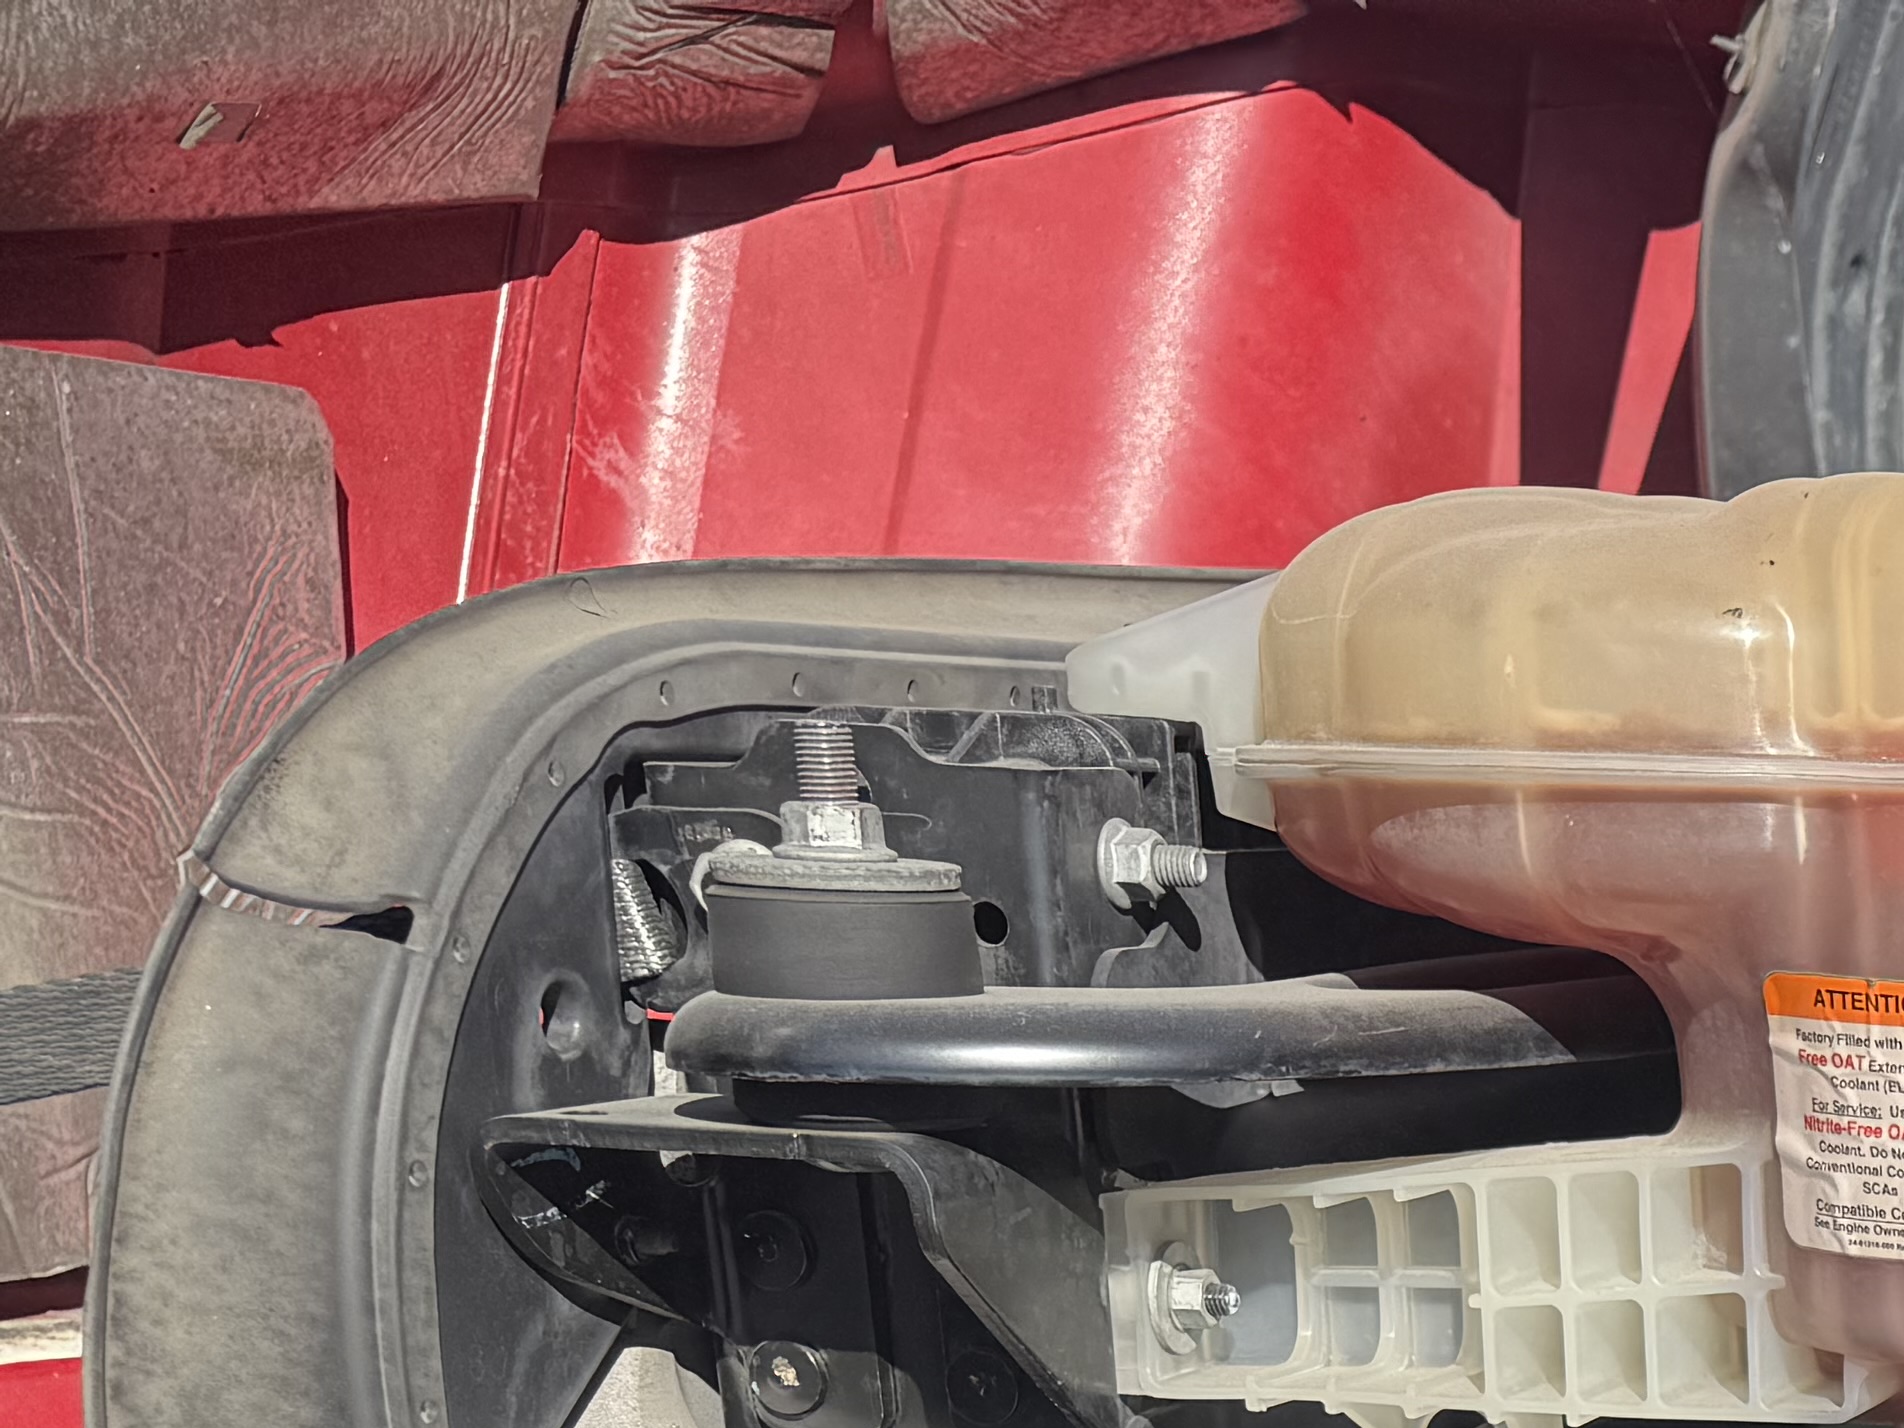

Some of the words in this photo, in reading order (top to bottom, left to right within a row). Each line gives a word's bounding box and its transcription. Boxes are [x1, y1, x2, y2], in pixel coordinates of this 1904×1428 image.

[1795, 1028, 1835, 1047] Factory
[1836, 1033, 1870, 1049] Filled
[1874, 1036, 1903, 1050] with
[1798, 1049, 1828, 1067] Free
[1832, 1053, 1866, 1071] OAT
[1830, 1076, 1880, 1092] Coolant
[1812, 1097, 1829, 1113] For
[1832, 1101, 1883, 1119] Service:
[1804, 1115, 1883, 1139] Nitrite-Free
[1818, 1140, 1866, 1157] Coolant.
[1869, 1145, 1888, 1159] Do
[1805, 1158, 1883, 1176] Conventional
[1862, 1182, 1898, 1196] SCAs
[1816, 1199, 1886, 1219] Compatible
[1814, 1216, 1830, 1229] See
[1832, 1219, 1870, 1236] Engine
